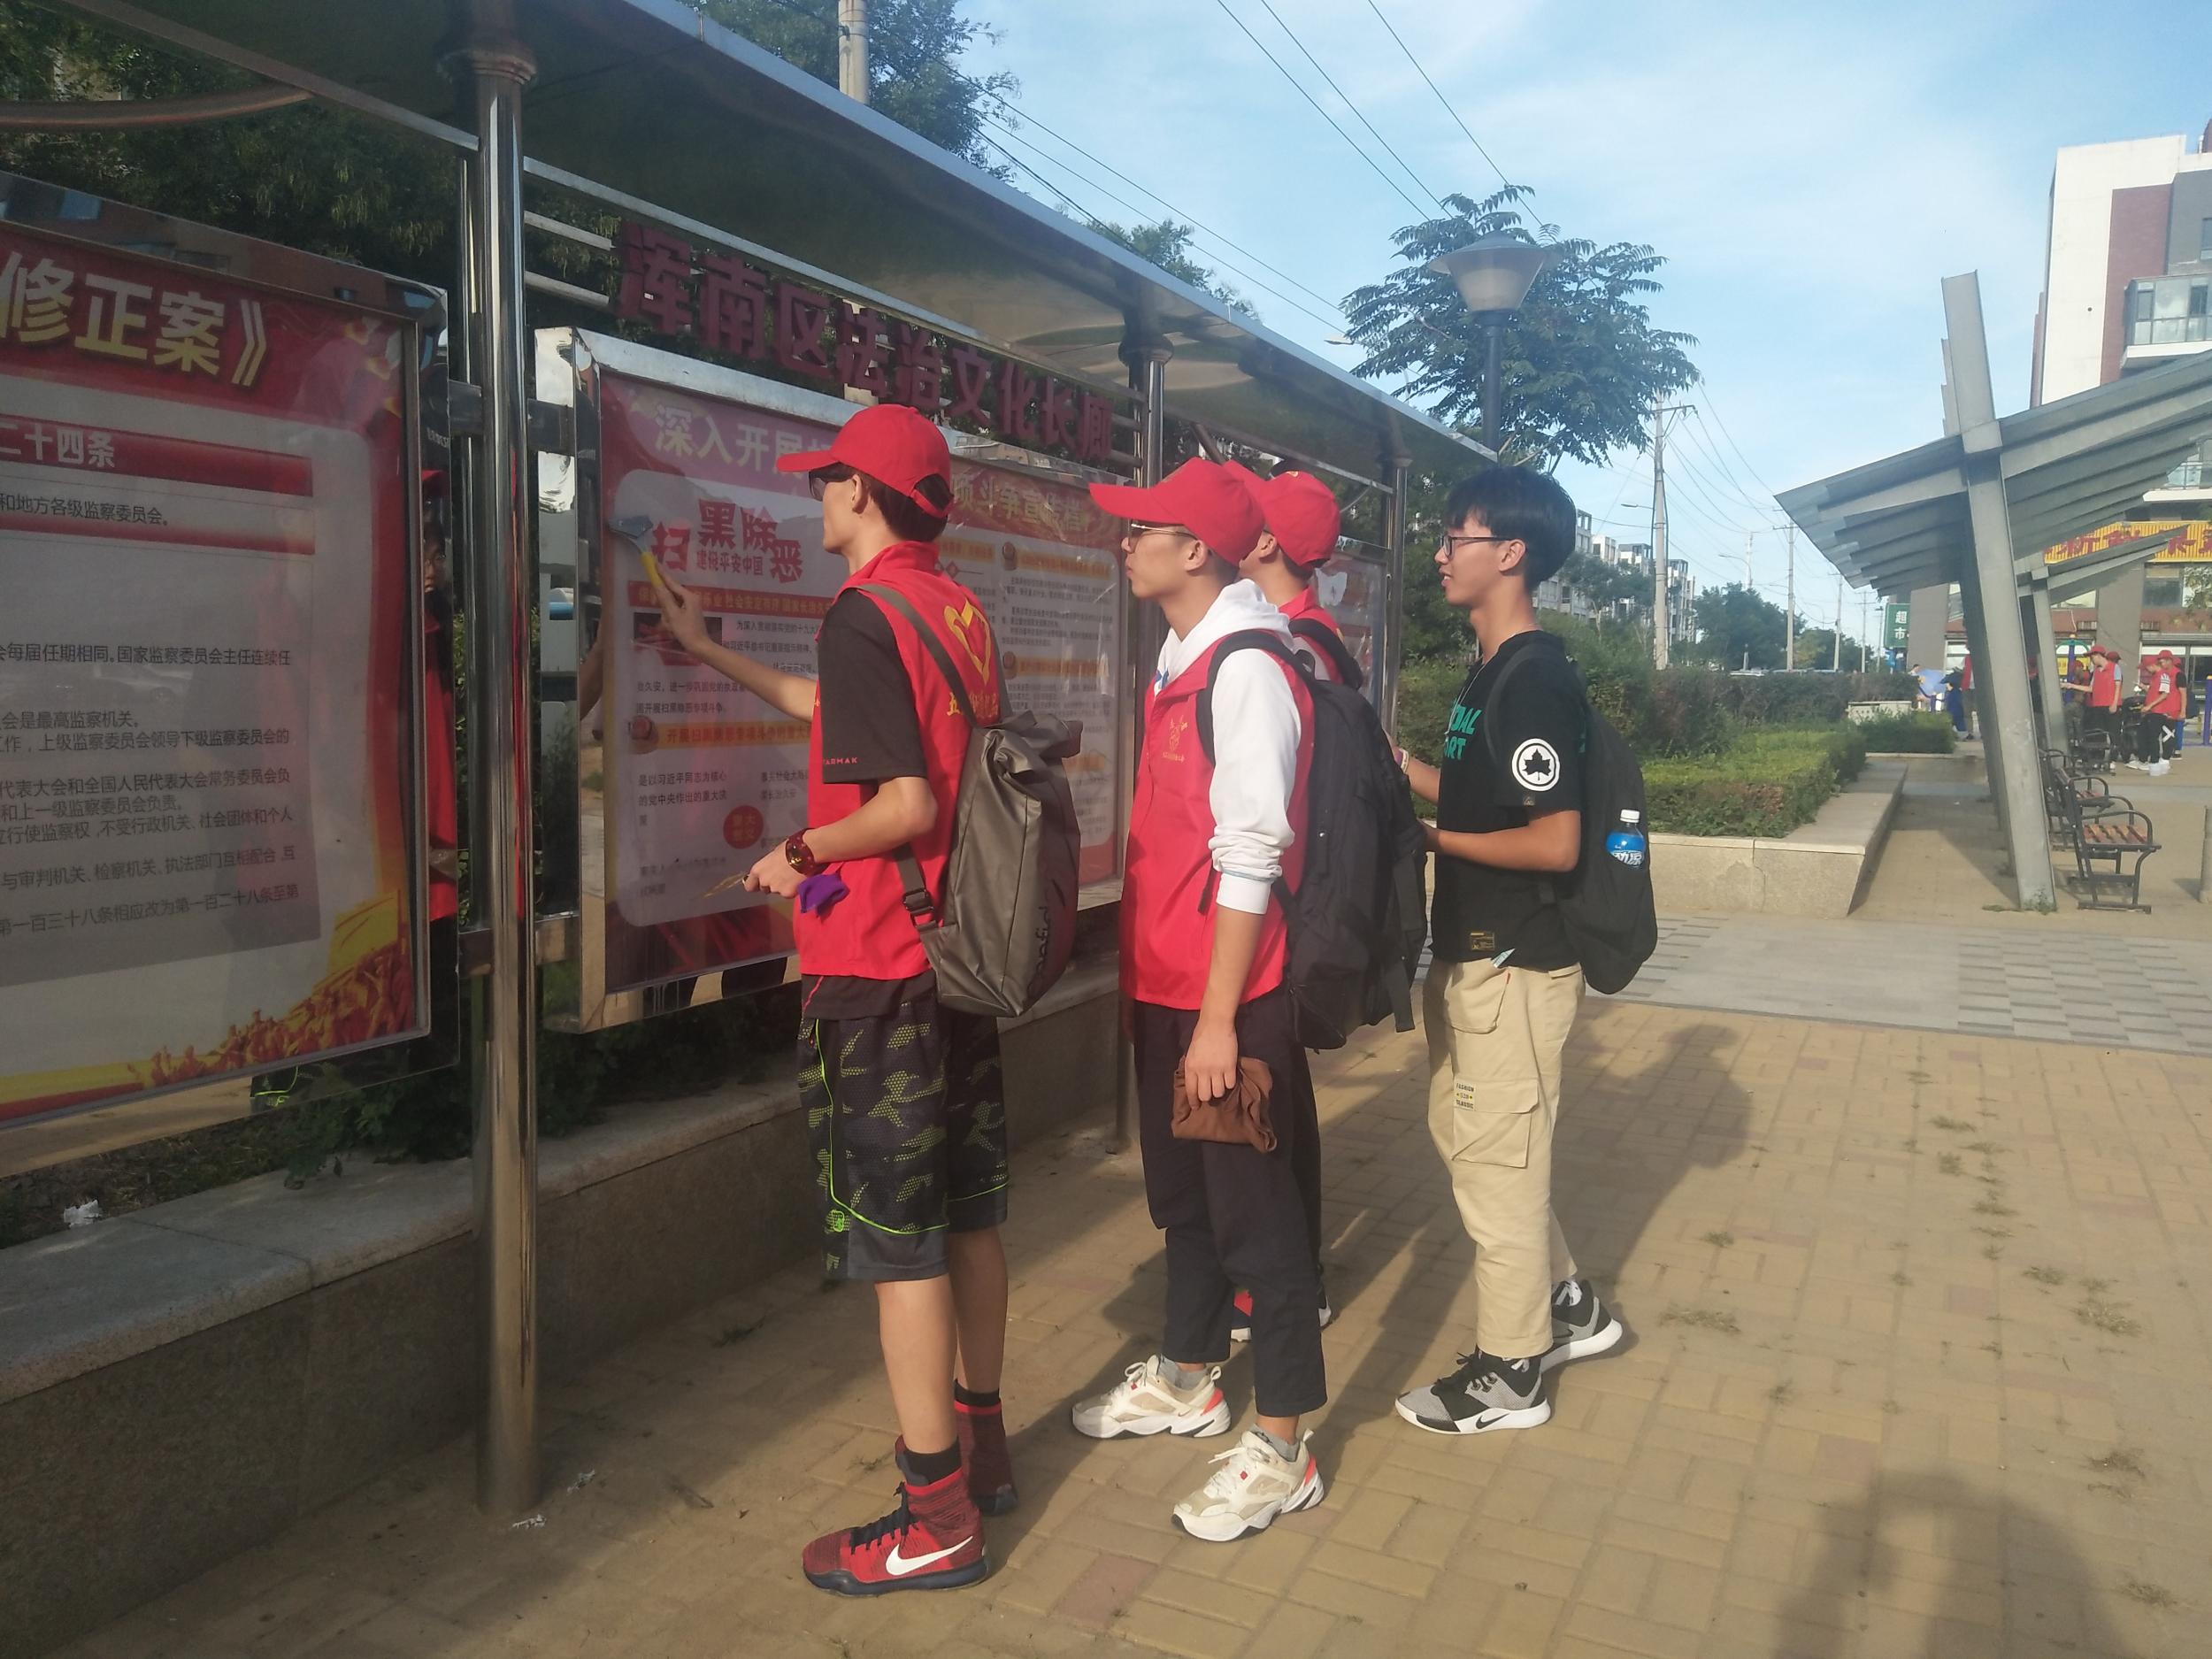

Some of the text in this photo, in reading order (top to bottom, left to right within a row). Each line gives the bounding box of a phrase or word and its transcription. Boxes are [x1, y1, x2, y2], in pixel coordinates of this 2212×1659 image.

[0, 252, 267, 388] 修正案》
[0, 419, 116, 469] 二十四条
[1893, 611, 1908, 640] 超市
